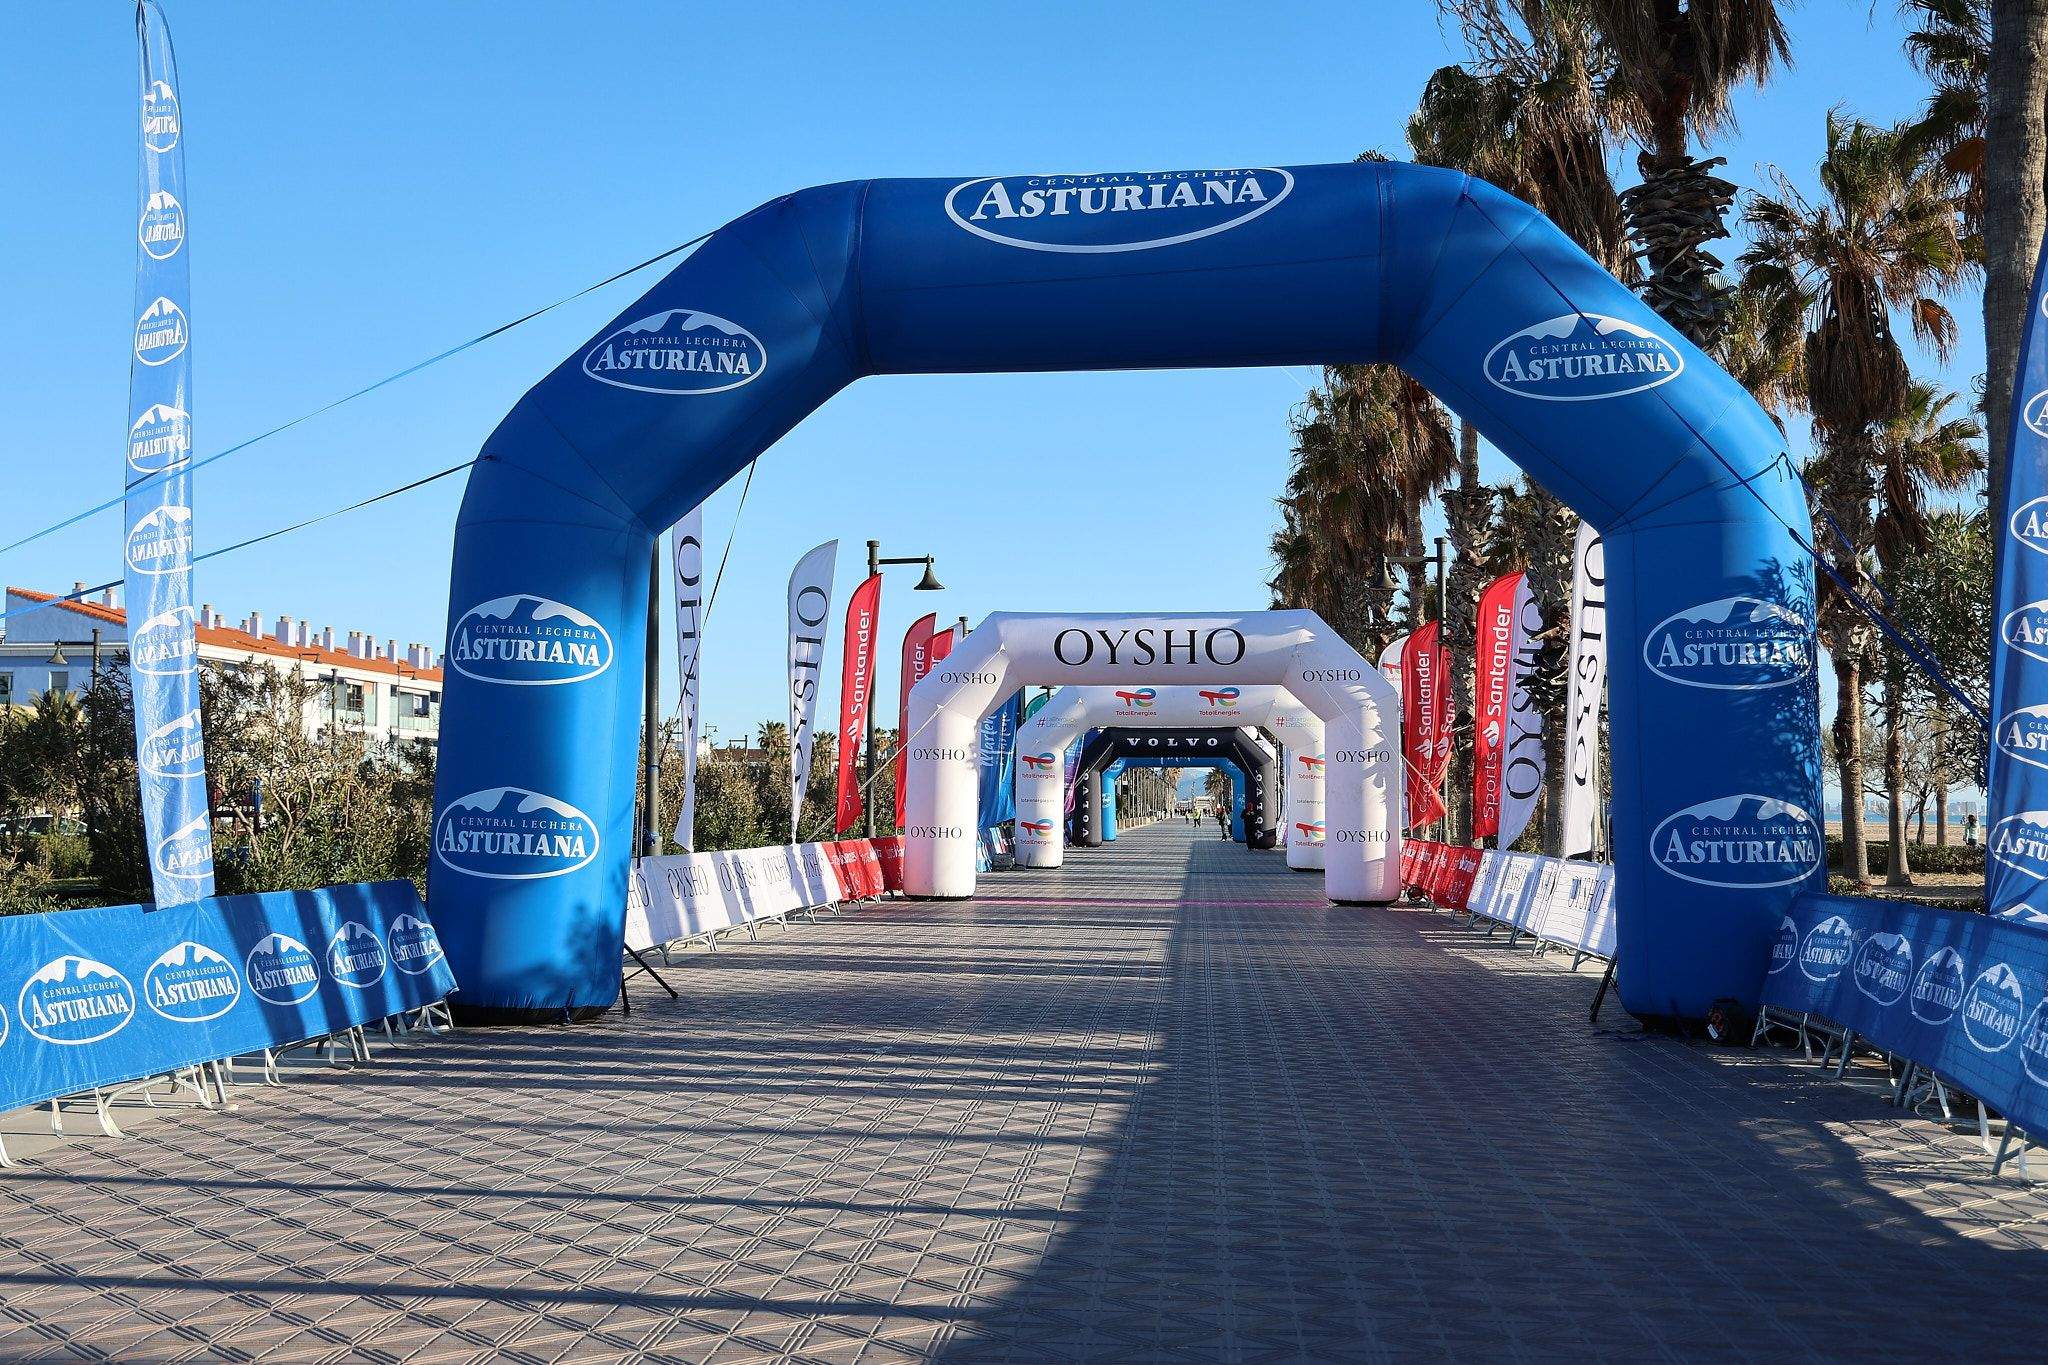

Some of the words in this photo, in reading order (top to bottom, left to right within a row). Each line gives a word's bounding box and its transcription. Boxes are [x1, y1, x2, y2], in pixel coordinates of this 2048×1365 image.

[1027, 176, 1135, 186] CENTRAL
[1147, 170, 1256, 180] LECHERA
[969, 177, 1268, 220] ASTURIANA
[624, 337, 680, 347] CENTRAL
[686, 337, 748, 349] LECHERA
[1530, 342, 1596, 355] CENTRAL
[1602, 340, 1662, 350] LECHERA
[592, 343, 751, 375] ASTURIANA
[1500, 350, 1674, 382] ASTURIANA
[476, 625, 531, 635] CENTRAL
[536, 626, 597, 640] LECHERA
[1685, 629, 1750, 639] CENTRAL
[455, 627, 600, 667] ASTURIANA
[1053, 627, 1247, 667] OYSHO
[850, 609, 870, 715] Santander
[1487, 604, 1511, 717] Santander
[940, 672, 997, 685] OYSHO
[1302, 669, 1361, 682] OYSHO
[1416, 651, 1432, 736] Santander
[913, 748, 965, 760] OYSHO
[1127, 738, 1219, 747] VOLVO
[1335, 750, 1391, 763] OYSHO
[1483, 752, 1499, 819] Sports
[461, 817, 516, 828] CENTRAL
[522, 819, 583, 831] LECHERA
[910, 826, 962, 839] OYSHO
[1692, 827, 1757, 836] CENTRAL
[441, 818, 587, 858] ASTURIANA
[1336, 829, 1391, 843] OYSHO
[1663, 829, 1816, 864] ASTURIANA
[668, 864, 709, 899] OYSHO
[165, 969, 199, 981] CENTRAL
[200, 965, 228, 978] LECHERA
[333, 949, 384, 976] ASTURIANA
[254, 963, 318, 991] ASTURIANA
[43, 986, 81, 1000] CENTRAL
[83, 980, 120, 994] LECHERA
[154, 975, 237, 1008] ASTURIANA
[32, 992, 131, 1029] ASTURIANA
